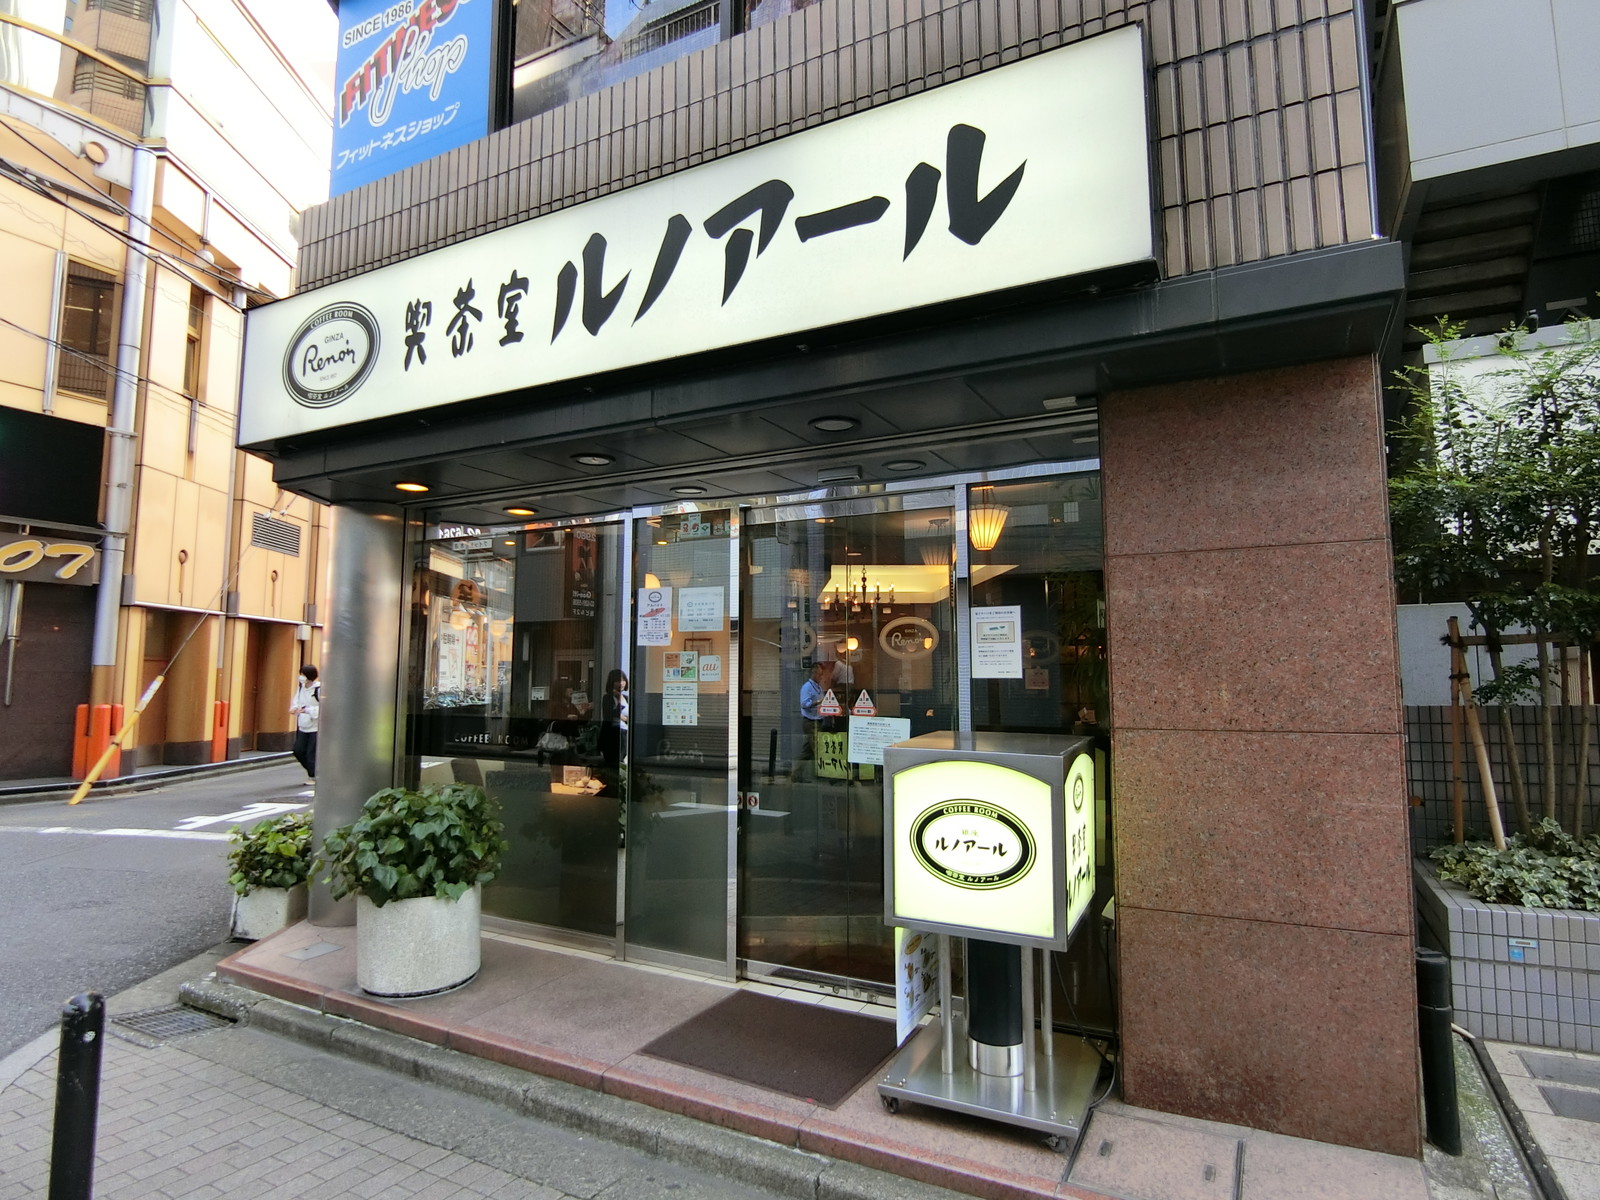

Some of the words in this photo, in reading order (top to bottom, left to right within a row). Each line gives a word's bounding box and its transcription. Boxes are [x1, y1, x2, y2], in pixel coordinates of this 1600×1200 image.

[344, 19, 381, 47] SINCE
[384, 3, 412, 26] 1986
[369, 26, 468, 127] Shop
[336, 102, 461, 169] フィットネスショップ
[310, 312, 333, 329] COFFEE
[334, 310, 354, 318] ROOM
[324, 332, 344, 344] GINZA
[303, 339, 356, 377] Renoir
[702, 663, 718, 671] au
[943, 805, 971, 815] COFFEE
[973, 806, 998, 819] ROOM
[935, 837, 1008, 857] ルノアール
